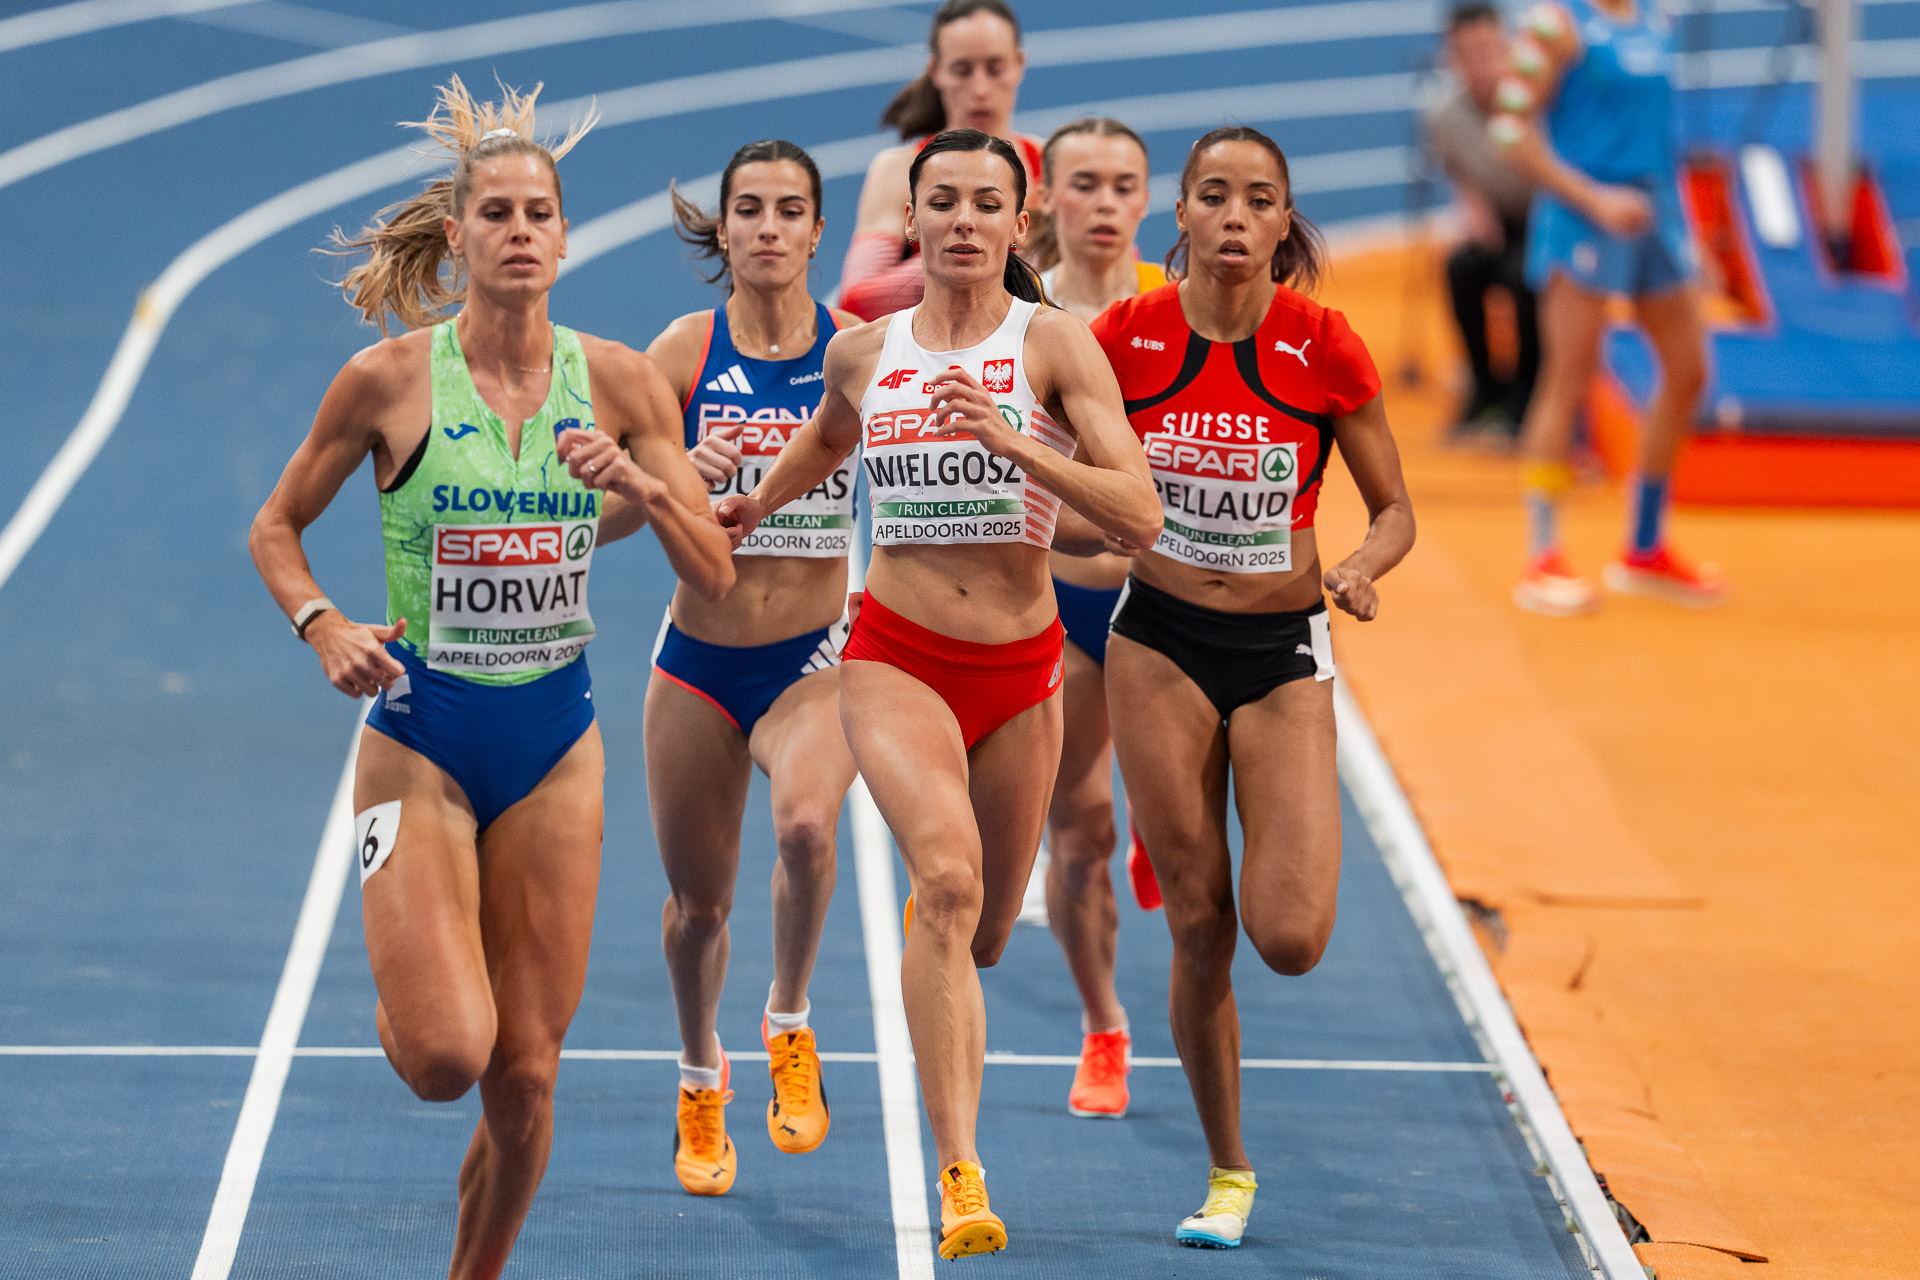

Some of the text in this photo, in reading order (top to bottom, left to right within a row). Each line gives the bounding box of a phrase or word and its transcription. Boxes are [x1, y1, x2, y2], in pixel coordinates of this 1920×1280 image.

[1143, 339, 1165, 351] UBS
[878, 369, 918, 389] 4F
[1148, 441, 1257, 477] SPAR
[864, 451, 1020, 487] WIELGOSZ
[433, 485, 596, 518] SLOVENIJA
[904, 503, 934, 516] RUN
[876, 521, 1021, 539] APELDOORN 2025
[441, 531, 559, 561] SPAR
[816, 536, 846, 549] 2025
[1249, 551, 1285, 566] 2025
[436, 570, 586, 613] HORVAT
[477, 629, 512, 643] RUN
[436, 649, 550, 666] APELDOORN
[363, 817, 378, 869] 6
